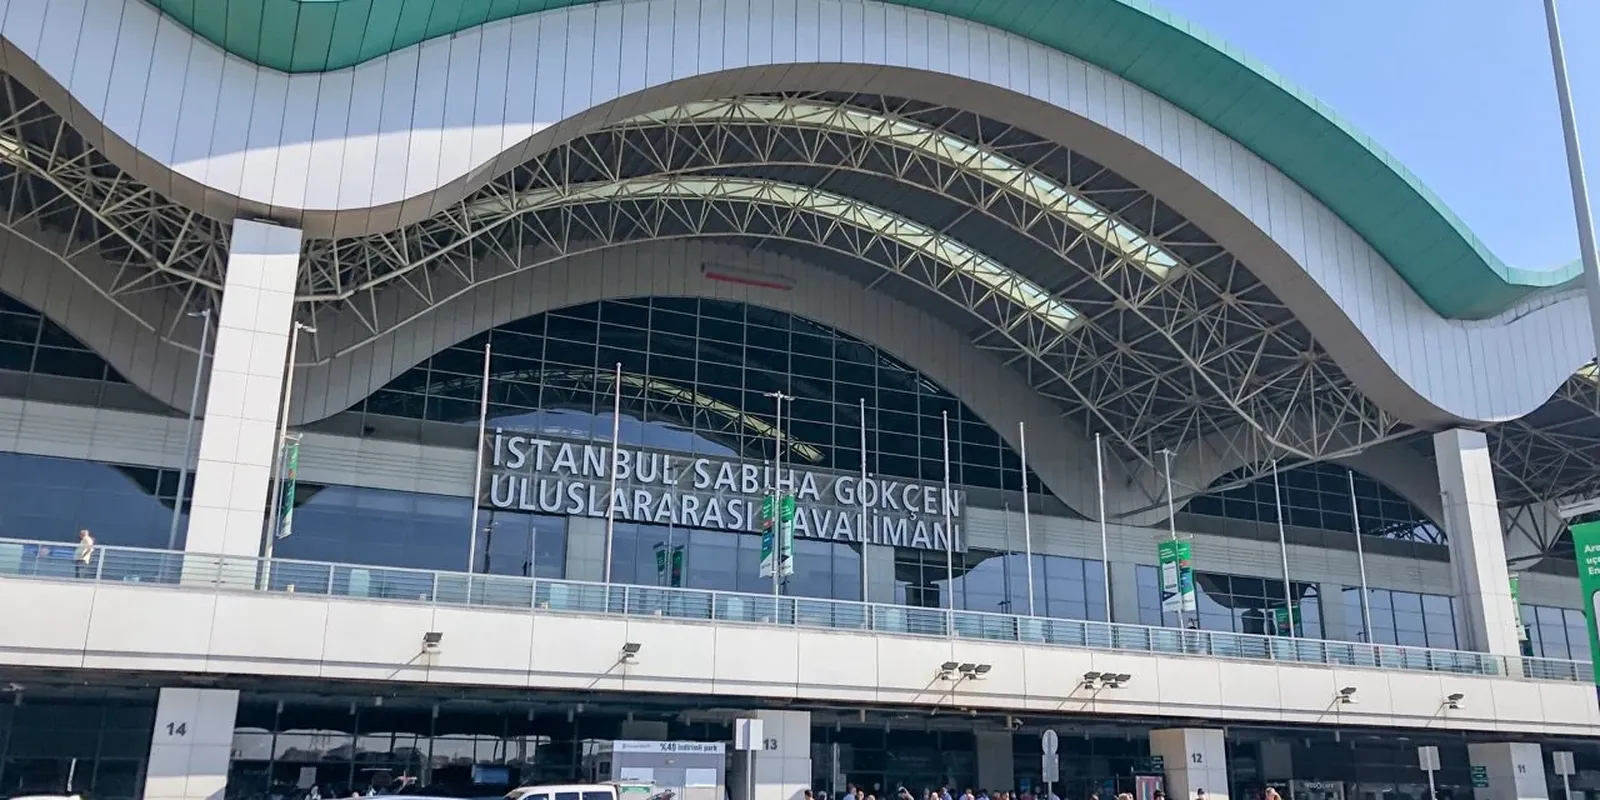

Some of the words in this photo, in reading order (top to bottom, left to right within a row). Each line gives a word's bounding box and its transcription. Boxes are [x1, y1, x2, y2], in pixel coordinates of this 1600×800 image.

[493, 427, 677, 485] İSTANBUL
[693, 458, 821, 501] SABİHA
[834, 472, 960, 521] GÖKÇEN
[490, 474, 753, 531] ULUSLARARASI
[793, 506, 960, 553] AVALİMANI
[166, 722, 187, 736] 14
[763, 738, 778, 750] 13
[1191, 753, 1203, 764] 12
[1517, 764, 1526, 774] 11
